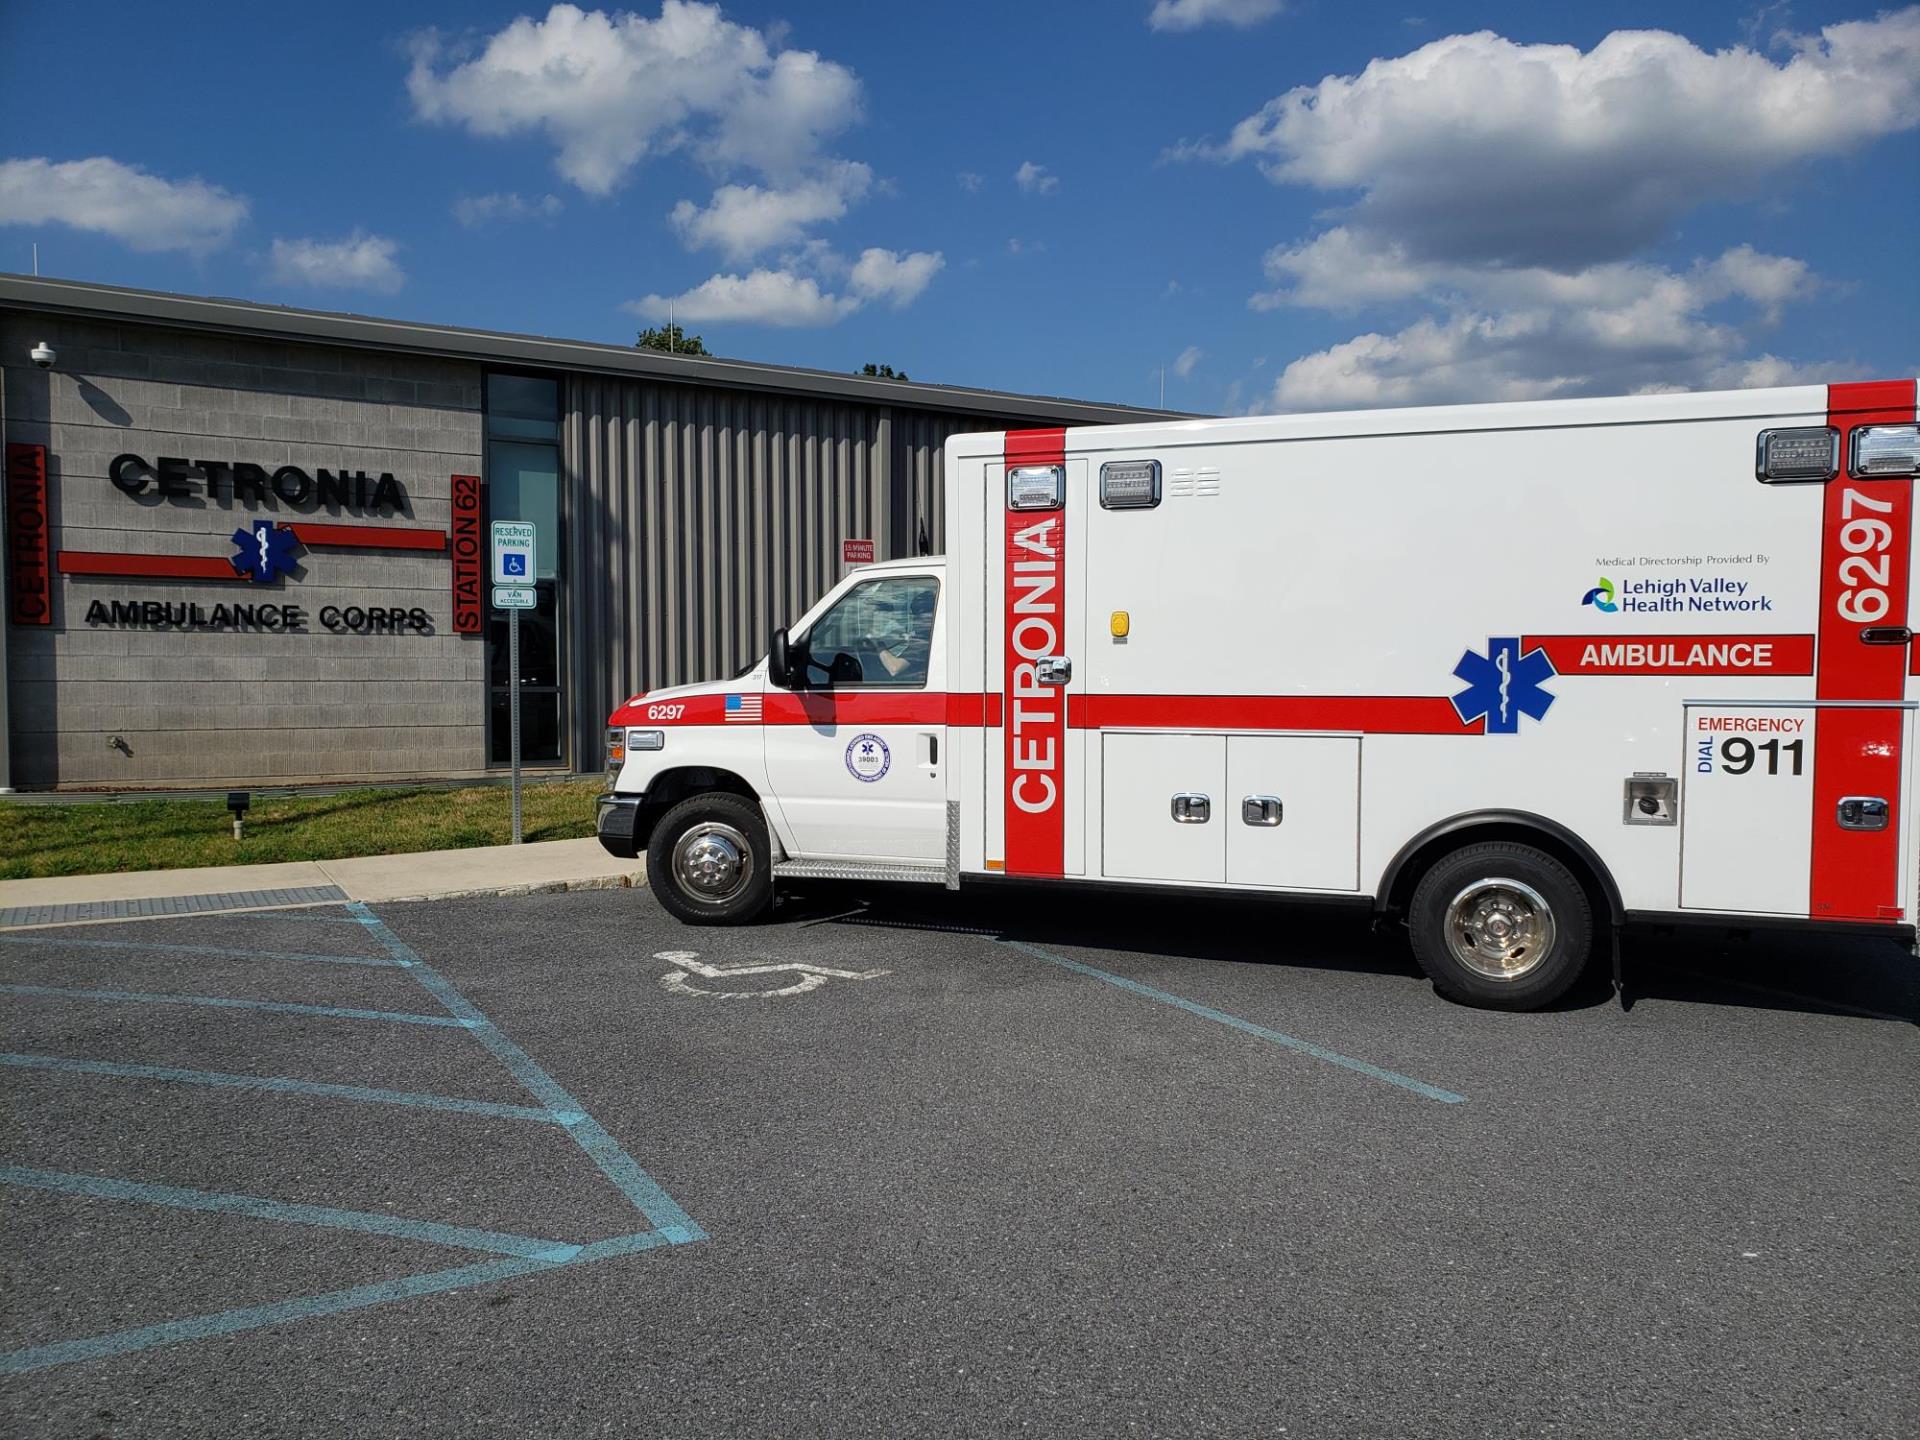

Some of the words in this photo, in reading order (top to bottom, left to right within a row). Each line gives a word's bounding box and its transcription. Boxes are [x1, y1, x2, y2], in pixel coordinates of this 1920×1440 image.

[109, 453, 404, 510] CETRONIA
[455, 478, 477, 511] 62
[14, 451, 46, 618] CETRONIA
[495, 527, 532, 537] RESERVED
[497, 538, 530, 547] PARKING
[1596, 557, 1635, 566] Medical
[1639, 556, 1702, 567] Directorship
[1707, 555, 1752, 564] Provided
[1757, 554, 1770, 565] By
[1837, 488, 1892, 623] 6297
[455, 517, 479, 629] STATION
[1623, 578, 1686, 597] Lehigh
[1690, 578, 1748, 596] Valley
[85, 600, 300, 627] AMBULANCE
[319, 605, 428, 629] CORPS
[1622, 597, 1684, 612] Health
[1688, 596, 1772, 612] Network
[1580, 643, 1772, 666] AMBULANCE
[648, 704, 685, 720] 6297
[1698, 717, 1804, 732] EMERGENCY
[1698, 736, 1713, 773] DIAL
[1721, 737, 1803, 776] 911
